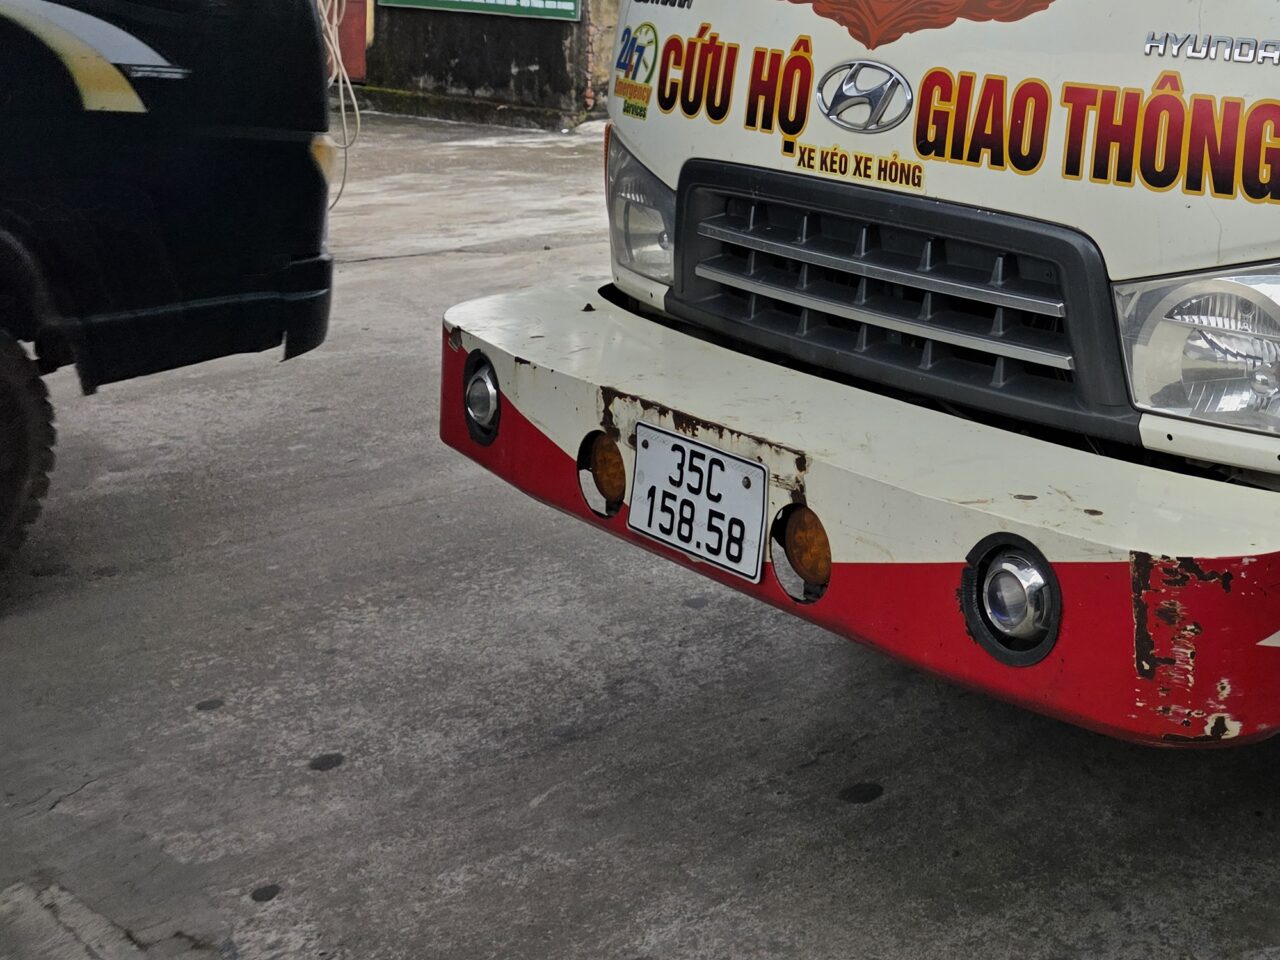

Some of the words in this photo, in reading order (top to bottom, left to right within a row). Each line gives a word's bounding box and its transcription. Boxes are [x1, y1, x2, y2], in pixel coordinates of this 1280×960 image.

[658, 23, 740, 124] CỨU
[744, 34, 815, 157] HỘ
[915, 66, 1051, 174] GIAO
[797, 145, 816, 170] XE
[819, 146, 849, 176] KÉO
[853, 154, 873, 179] XE
[877, 153, 923, 188] HỎNG
[667, 443, 725, 503] 35C
[647, 485, 746, 564] 158.58
